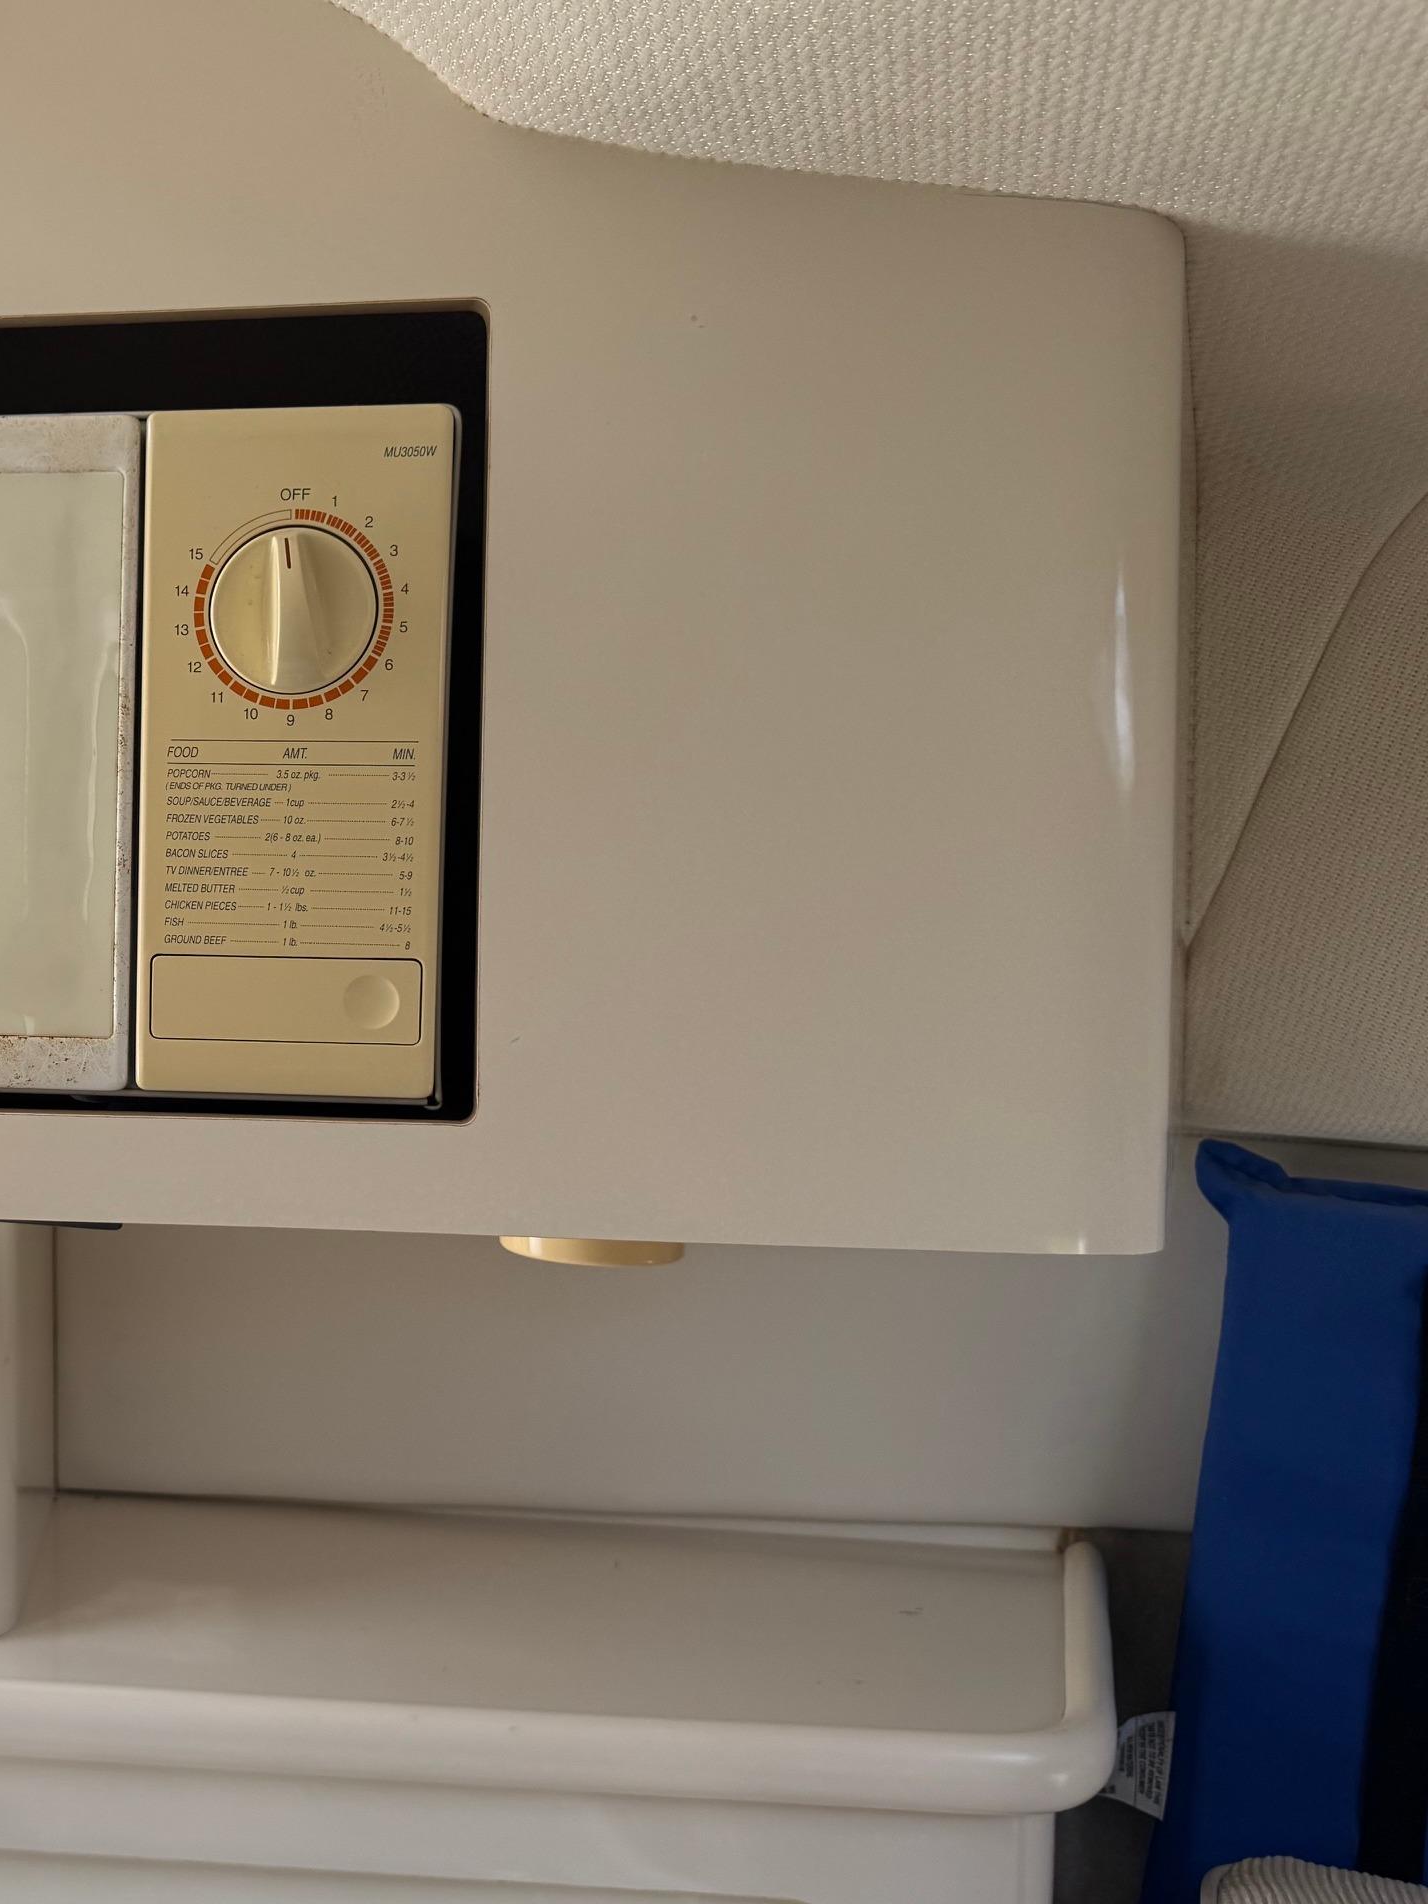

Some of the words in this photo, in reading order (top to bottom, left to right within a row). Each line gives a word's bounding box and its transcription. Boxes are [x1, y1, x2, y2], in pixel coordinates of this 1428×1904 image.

[384, 446, 437, 457] MU3050W
[280, 488, 311, 500] OFF
[332, 496, 338, 507] 1
[365, 516, 374, 528] 2
[189, 548, 204, 560] 15
[389, 545, 399, 556] 3
[174, 585, 190, 596] 14
[401, 584, 410, 594] 4
[174, 624, 189, 636] 13
[399, 622, 408, 633] 5
[188, 662, 202, 673] 12
[385, 659, 394, 670] 6
[211, 692, 224, 703] 11
[361, 690, 369, 701] 7
[244, 708, 259, 720] 10
[325, 708, 333, 720] 8
[286, 714, 295, 726] 9
[167, 746, 199, 758] FOOD
[282, 747, 308, 759] AMT.
[392, 748, 416, 760] MIN.
[167, 769, 211, 778] POPCORN
[276, 770, 289, 779] 3.5
[304, 770, 320, 781] pkg.
[192, 782, 205, 790] OF
[226, 783, 258, 791] TURNED
[166, 796, 272, 807] SOUP/SAUCE/BEVERAGE
[166, 814, 202, 823] FROZEN
[204, 814, 259, 824] VEGETABLES
[283, 816, 292, 824] 10
[166, 831, 211, 841] POTATOES
[306, 833, 321, 844] ea.)
[395, 836, 414, 845] 8-10
[166, 848, 196, 858] BACON
[198, 849, 228, 859] SLICES
[291, 850, 296, 859] 4
[166, 866, 177, 875] TV
[178, 866, 249, 876] DINNER/ENTREE
[270, 868, 275, 876] 7
[399, 871, 412, 880] 5-9
[165, 883, 198, 892] MELTED
[201, 884, 235, 893] BUTTER
[165, 900, 203, 910] CHICKEN
[205, 901, 237, 911] PIECES
[295, 903, 308, 912] lbs.
[389, 906, 411, 916] 11-15
[164, 917, 184, 926] FISH
[289, 920, 297, 928] lb.
[164, 935, 202, 944] GROUND
[204, 936, 227, 944] BEEF
[289, 938, 297, 946] lb.
[405, 941, 410, 950] 8
